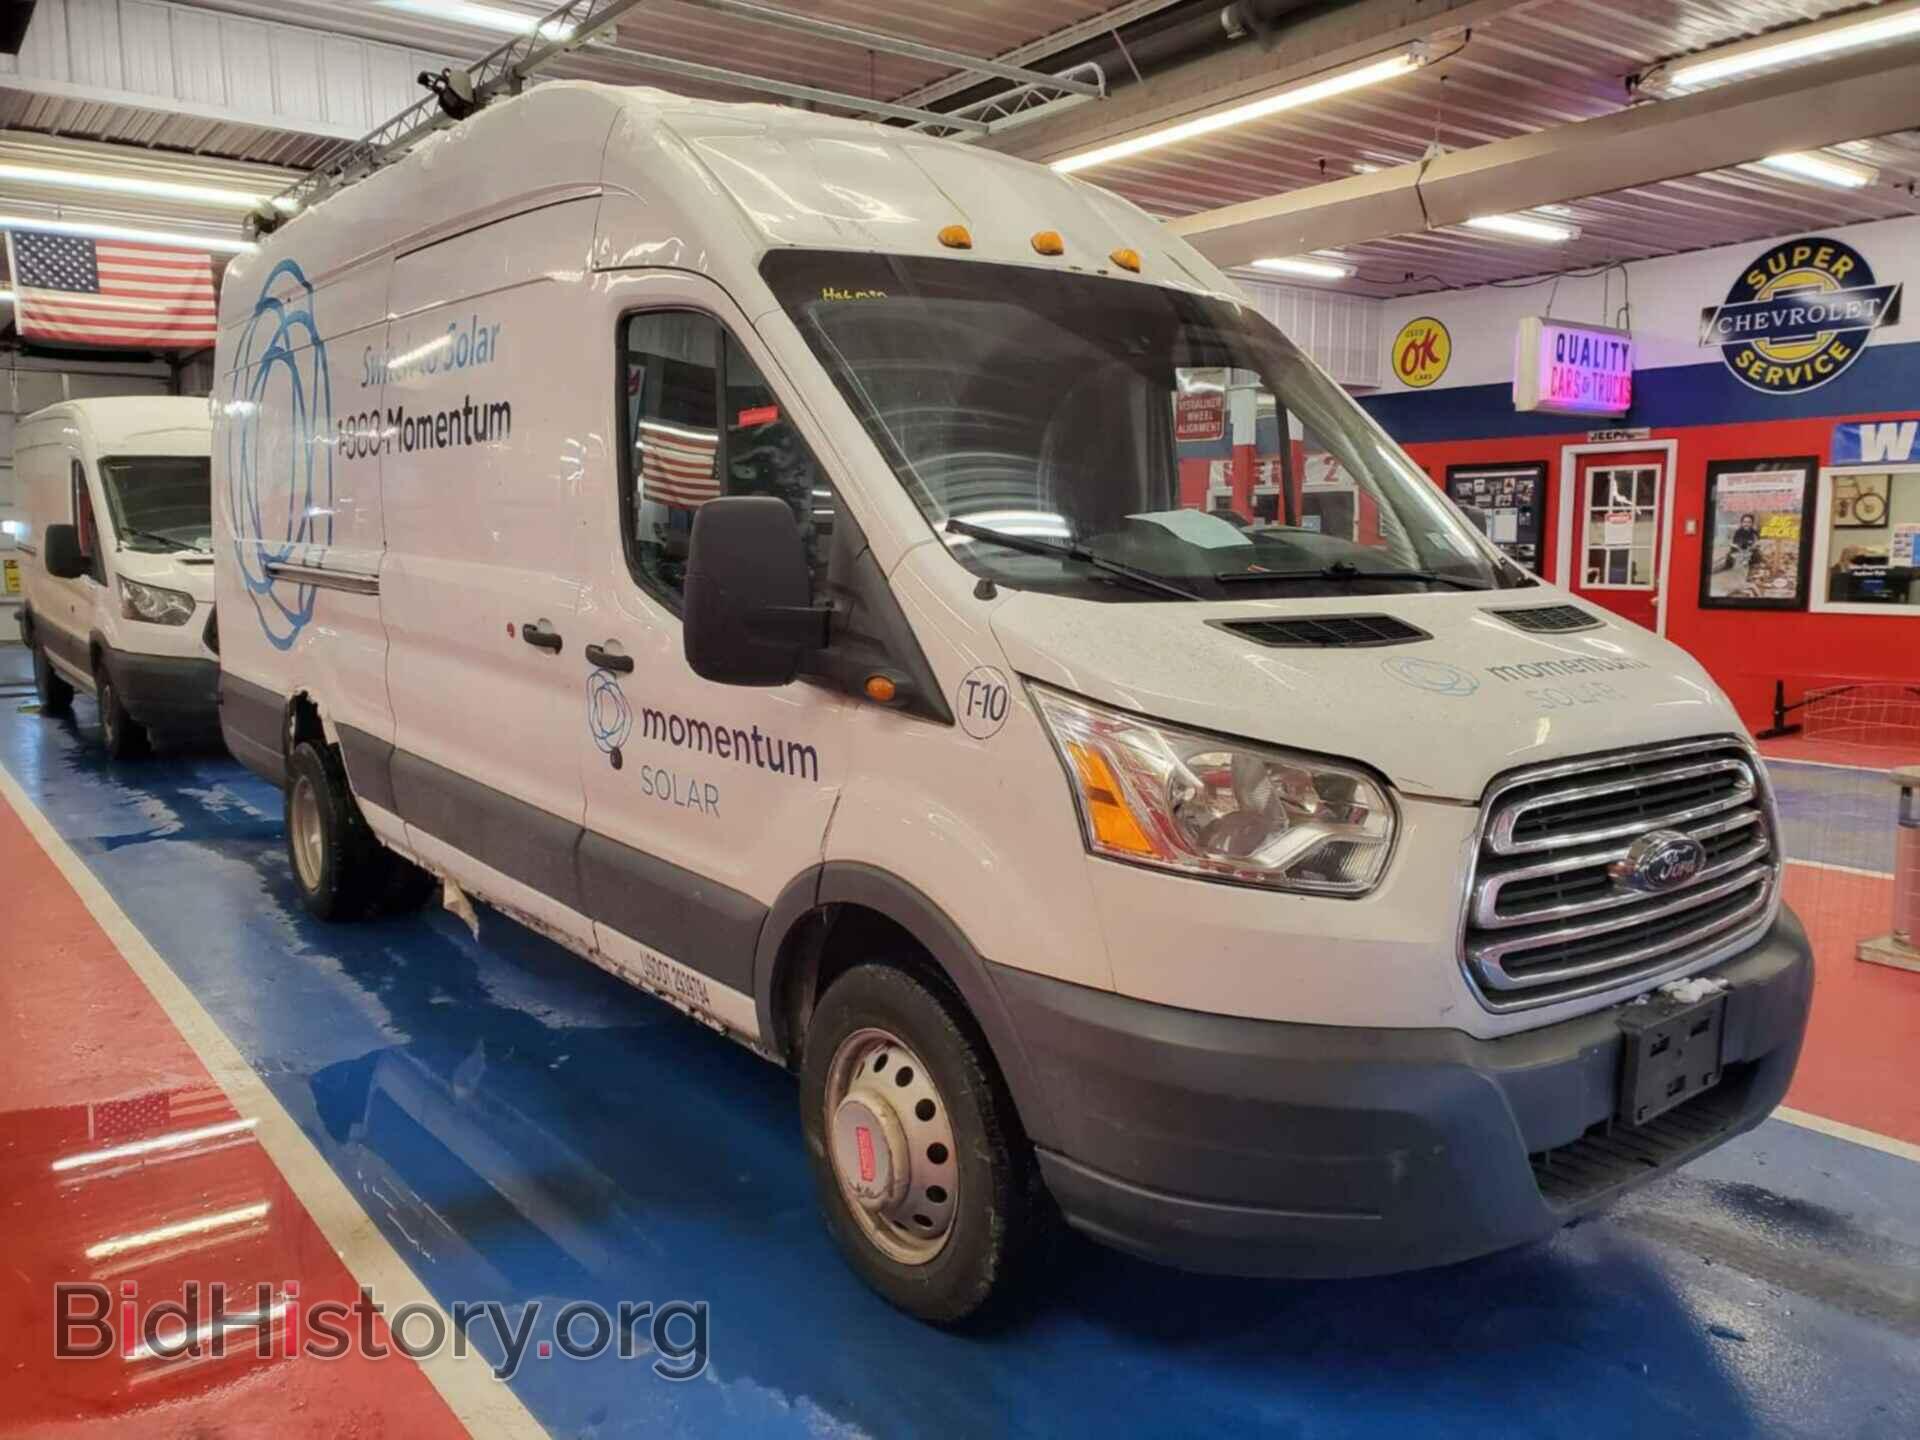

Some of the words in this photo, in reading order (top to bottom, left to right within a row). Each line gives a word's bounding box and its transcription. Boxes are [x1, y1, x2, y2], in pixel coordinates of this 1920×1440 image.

[1746, 245, 1856, 290] SUPER
[1717, 297, 1881, 334] CHEVROLET
[443, 314, 502, 371] Solar
[1401, 328, 1441, 376] OK
[1556, 332, 1630, 372] QUALITY
[1735, 340, 1852, 385] SERVICE
[1551, 366, 1582, 399] CARS
[1592, 371, 1632, 406] TRUCKS
[1177, 422, 1222, 434] ALIGNMENT
[1187, 410, 1214, 421] WHEEL
[966, 680, 1008, 721] T-10
[642, 707, 818, 782] momentum
[641, 765, 720, 818] SOLAR
